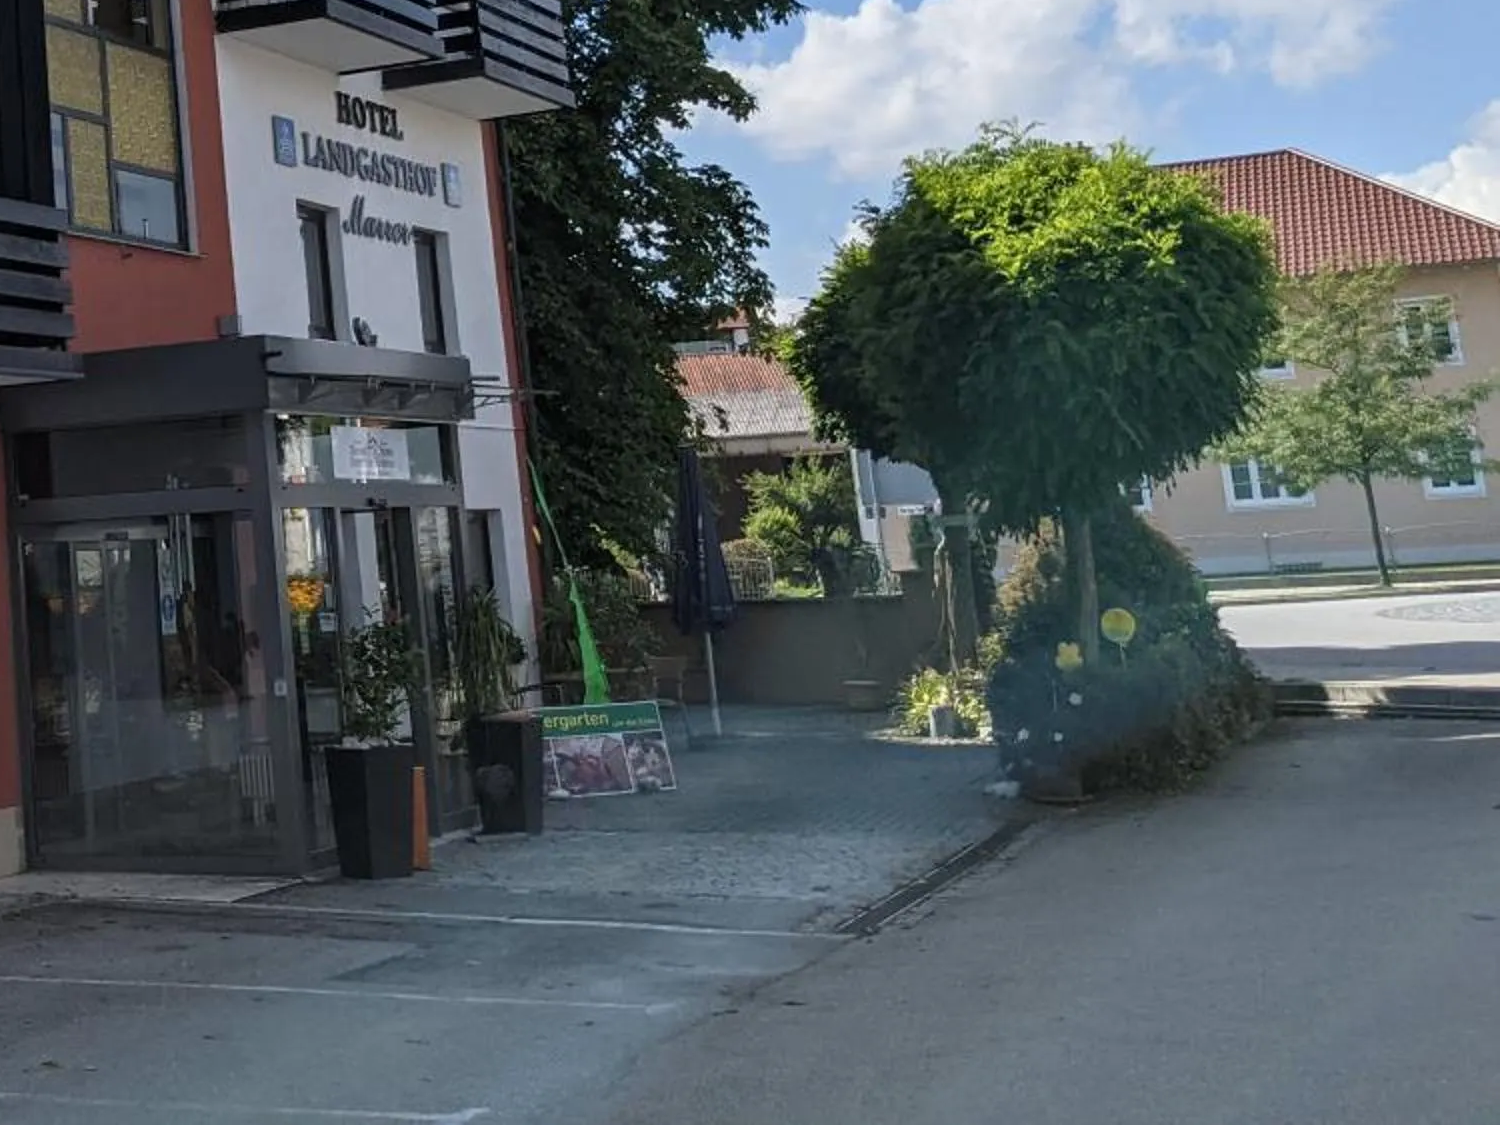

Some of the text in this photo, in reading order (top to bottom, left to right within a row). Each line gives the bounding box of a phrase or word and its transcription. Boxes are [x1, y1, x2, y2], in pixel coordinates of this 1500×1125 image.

[335, 91, 404, 141] HOTEL
[301, 131, 437, 197] LANDGASTHOF
[543, 712, 609, 731] ergarten
